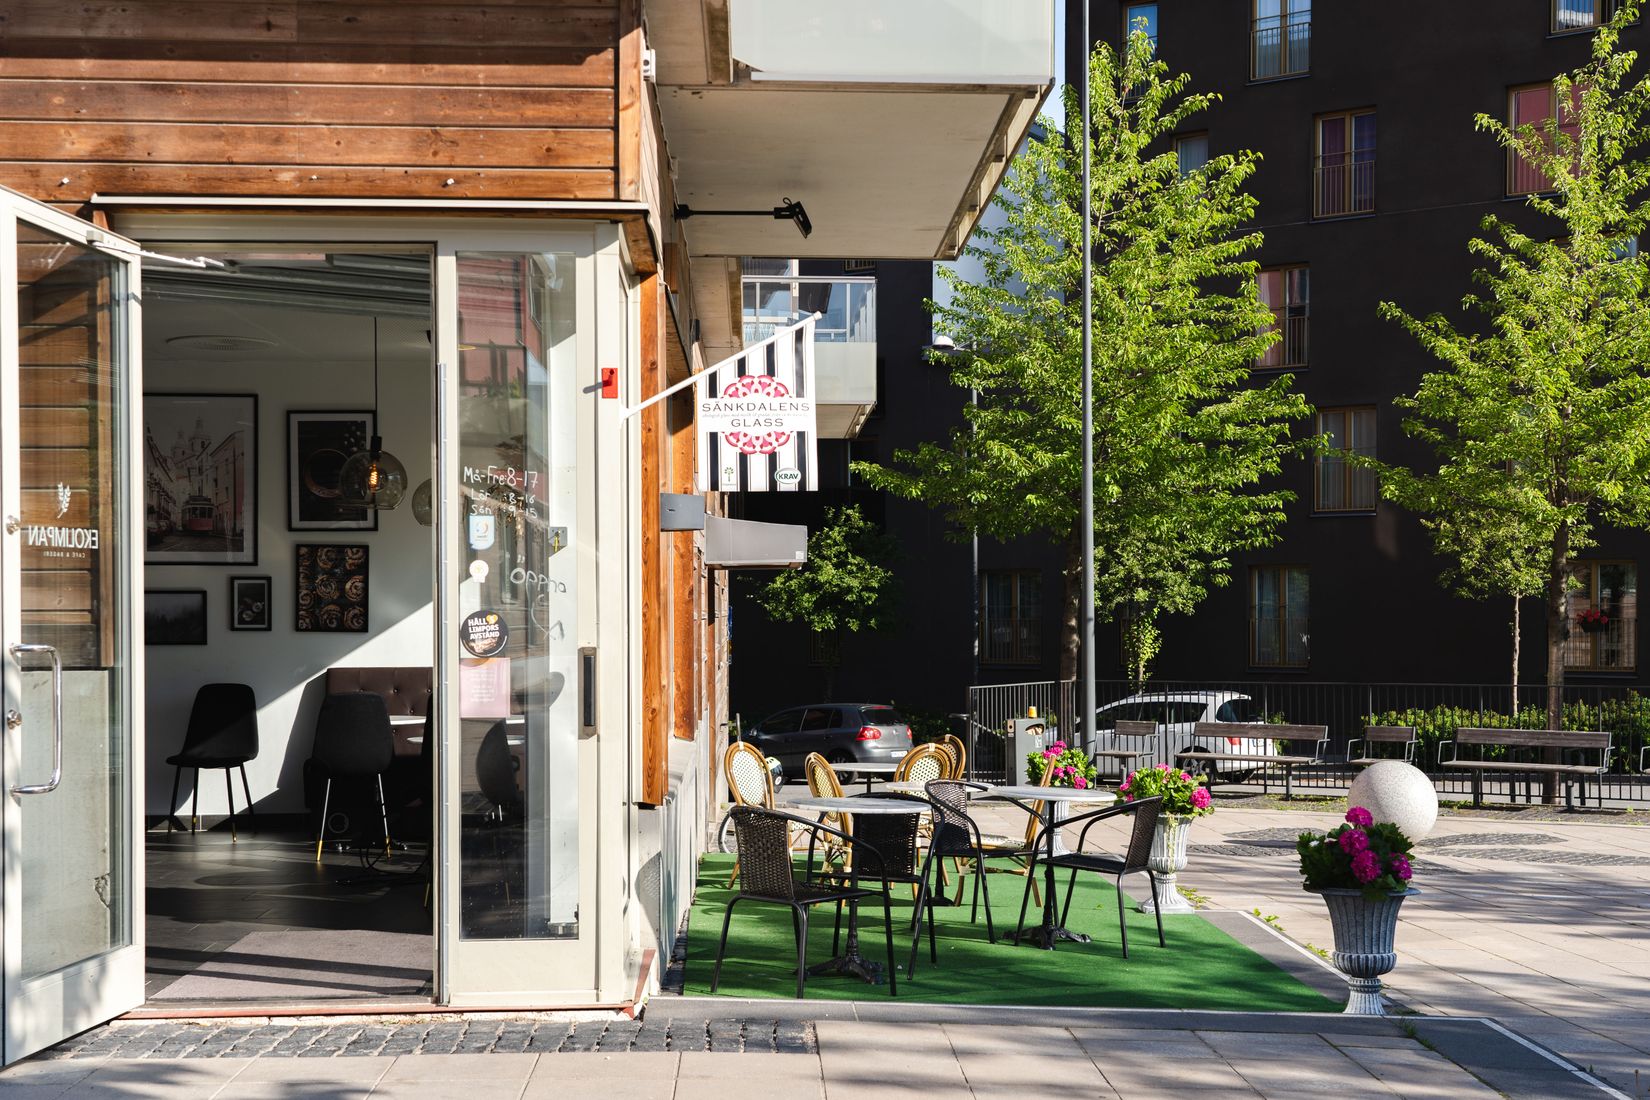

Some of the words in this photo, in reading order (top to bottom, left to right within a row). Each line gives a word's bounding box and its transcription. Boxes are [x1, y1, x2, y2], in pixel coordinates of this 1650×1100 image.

[702, 401, 810, 412] SÄNKDALENS
[731, 418, 784, 428] GLASS
[778, 472, 799, 480] KRAV
[468, 617, 488, 627] HÅLL
[469, 631, 500, 640] AVSTÅND
